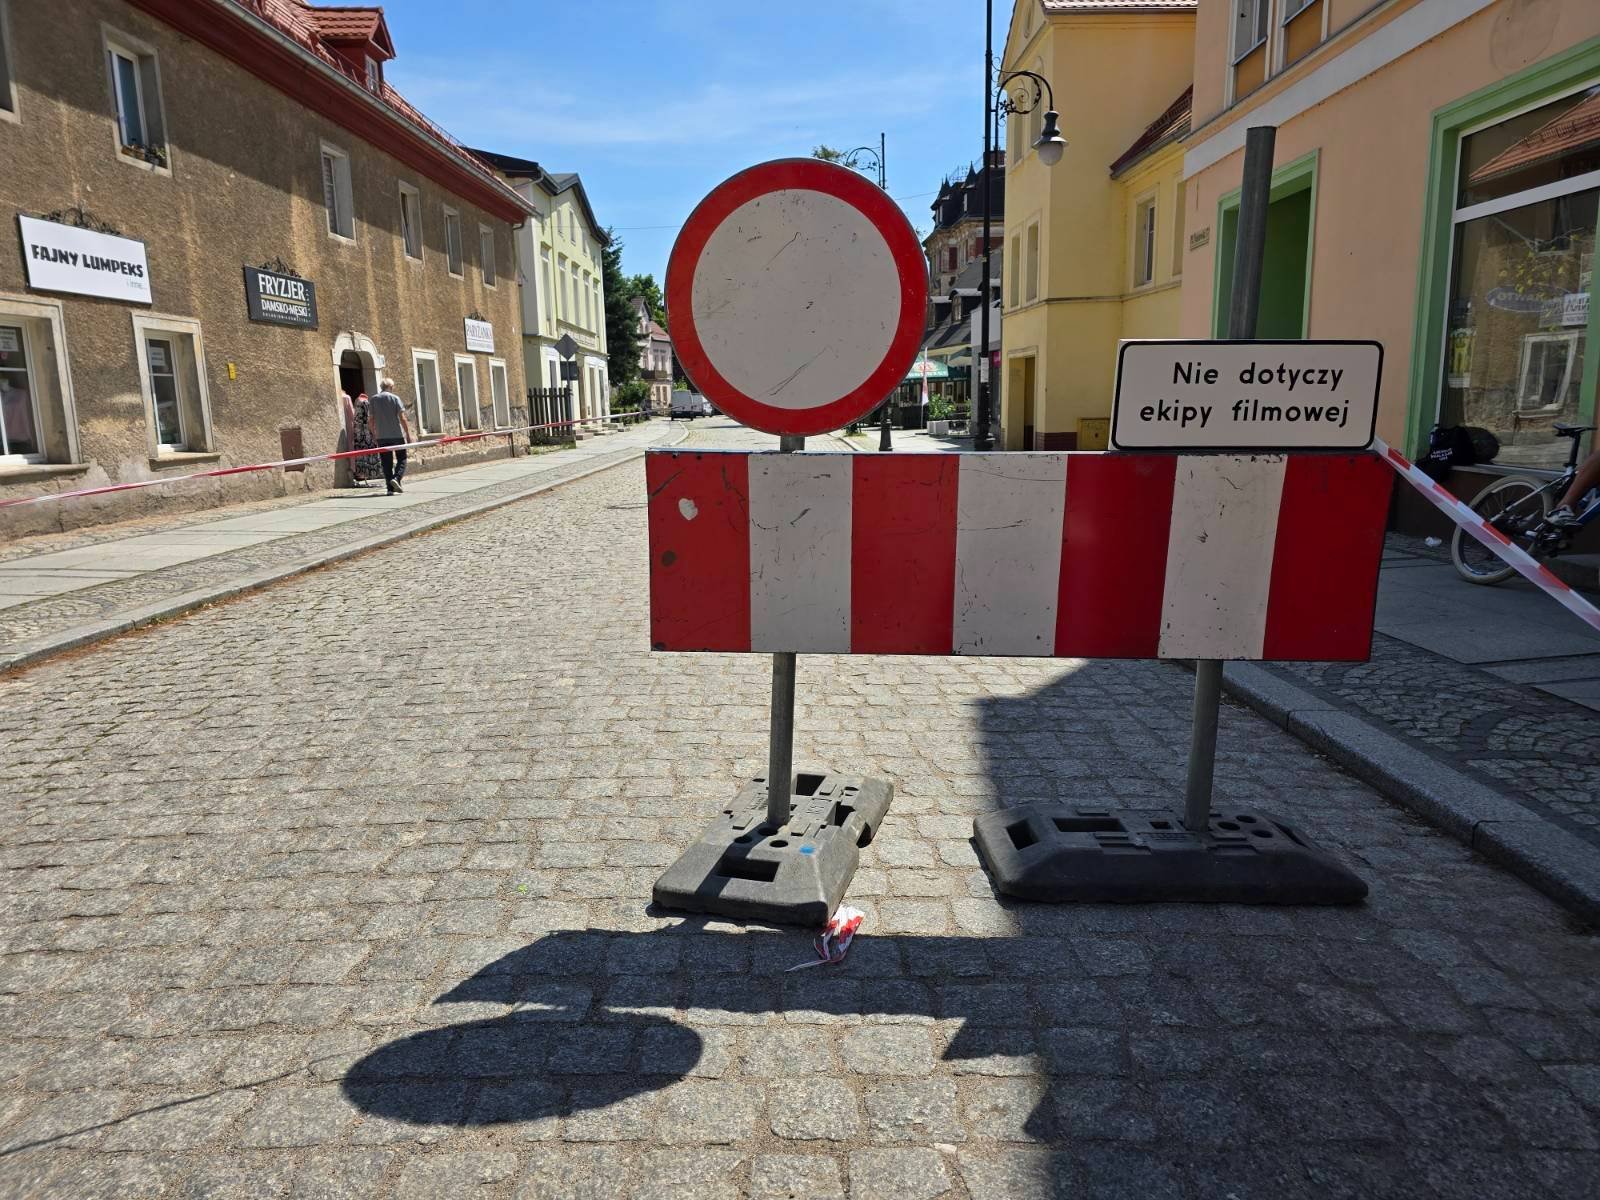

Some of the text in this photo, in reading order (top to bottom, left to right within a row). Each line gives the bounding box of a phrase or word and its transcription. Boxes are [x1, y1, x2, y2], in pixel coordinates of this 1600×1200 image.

[31, 244, 144, 278] FAJNY LUMPEKS
[257, 273, 306, 301] FRYZJER
[1173, 362, 1344, 391] Nie dotyczy
[1139, 399, 1349, 428] ekipy filmowej
